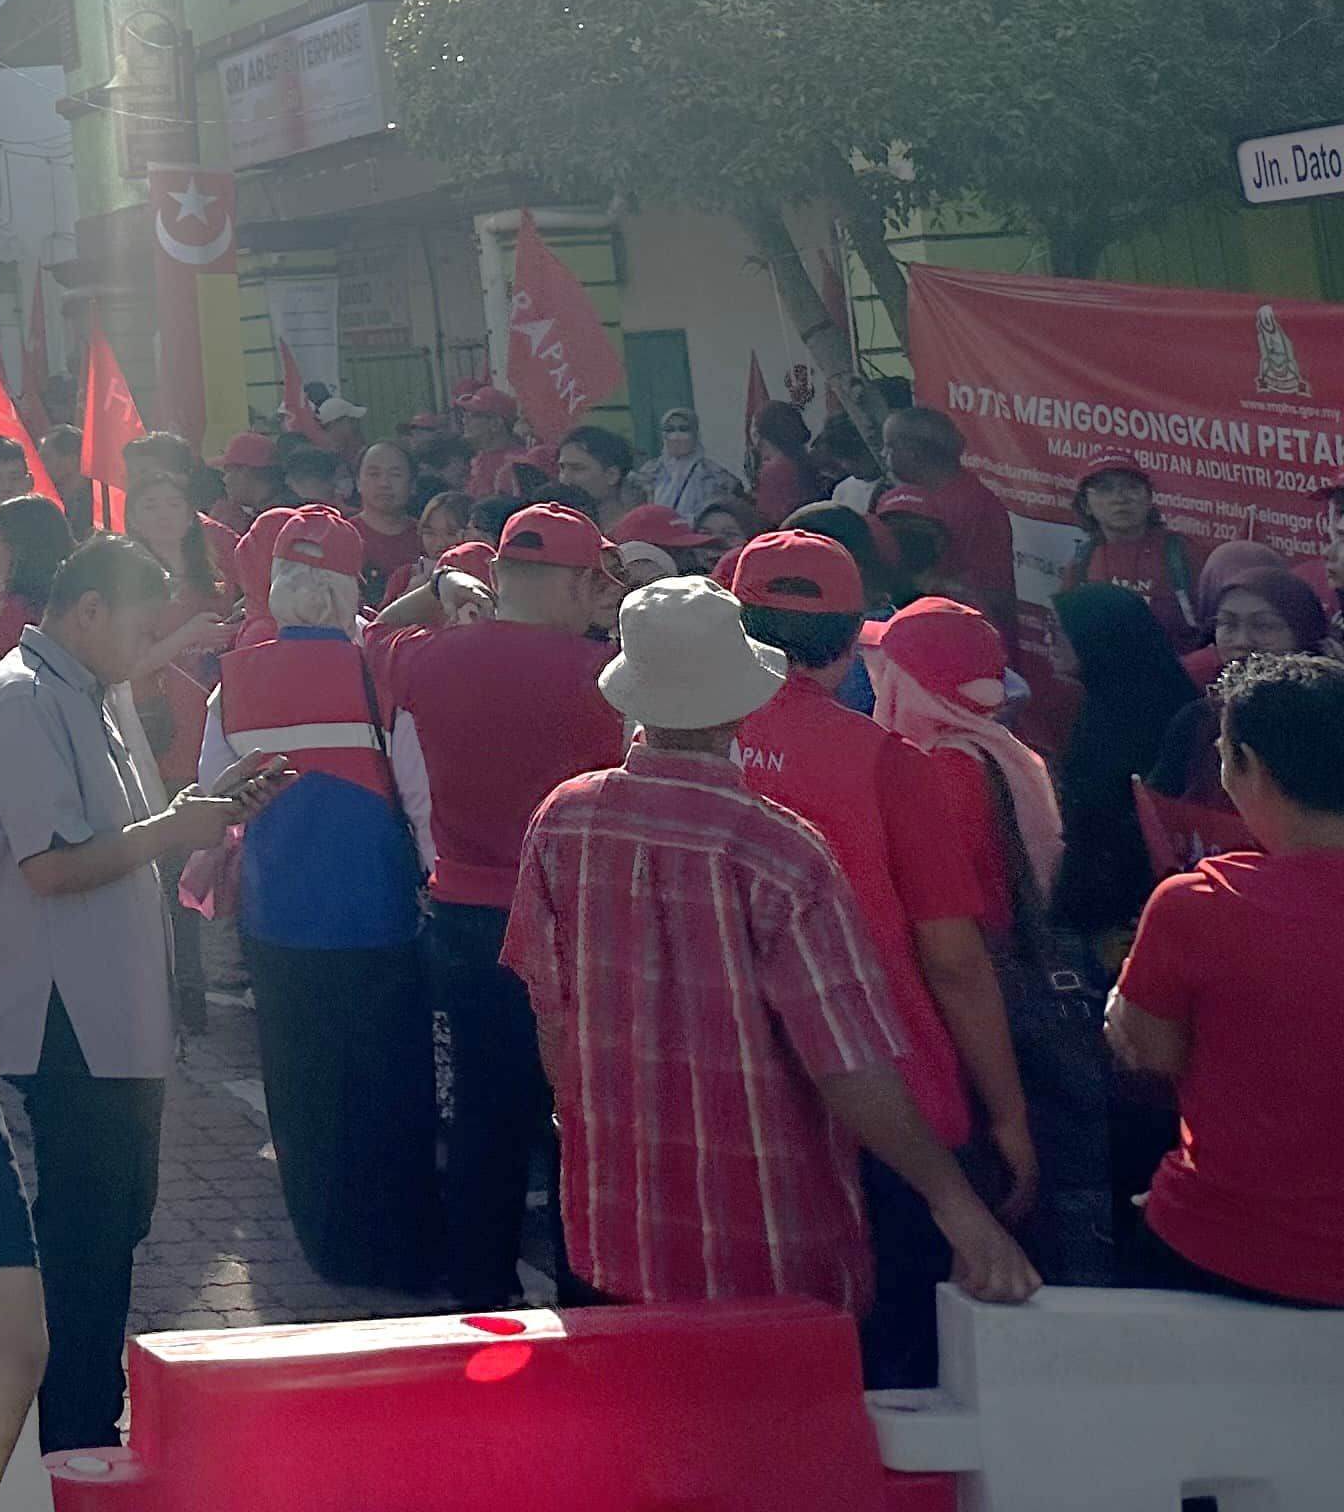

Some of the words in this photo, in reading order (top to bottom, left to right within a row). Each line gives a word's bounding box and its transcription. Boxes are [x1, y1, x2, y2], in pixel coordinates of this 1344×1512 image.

[1253, 151, 1288, 188] Jln.
[1292, 143, 1341, 182] Dato
[1013, 394, 1250, 456] MENGOSONGKAN
[1195, 458, 1272, 489] AIDILFITRI
[1274, 469, 1320, 493] 2024
[1258, 506, 1313, 534] elangor
